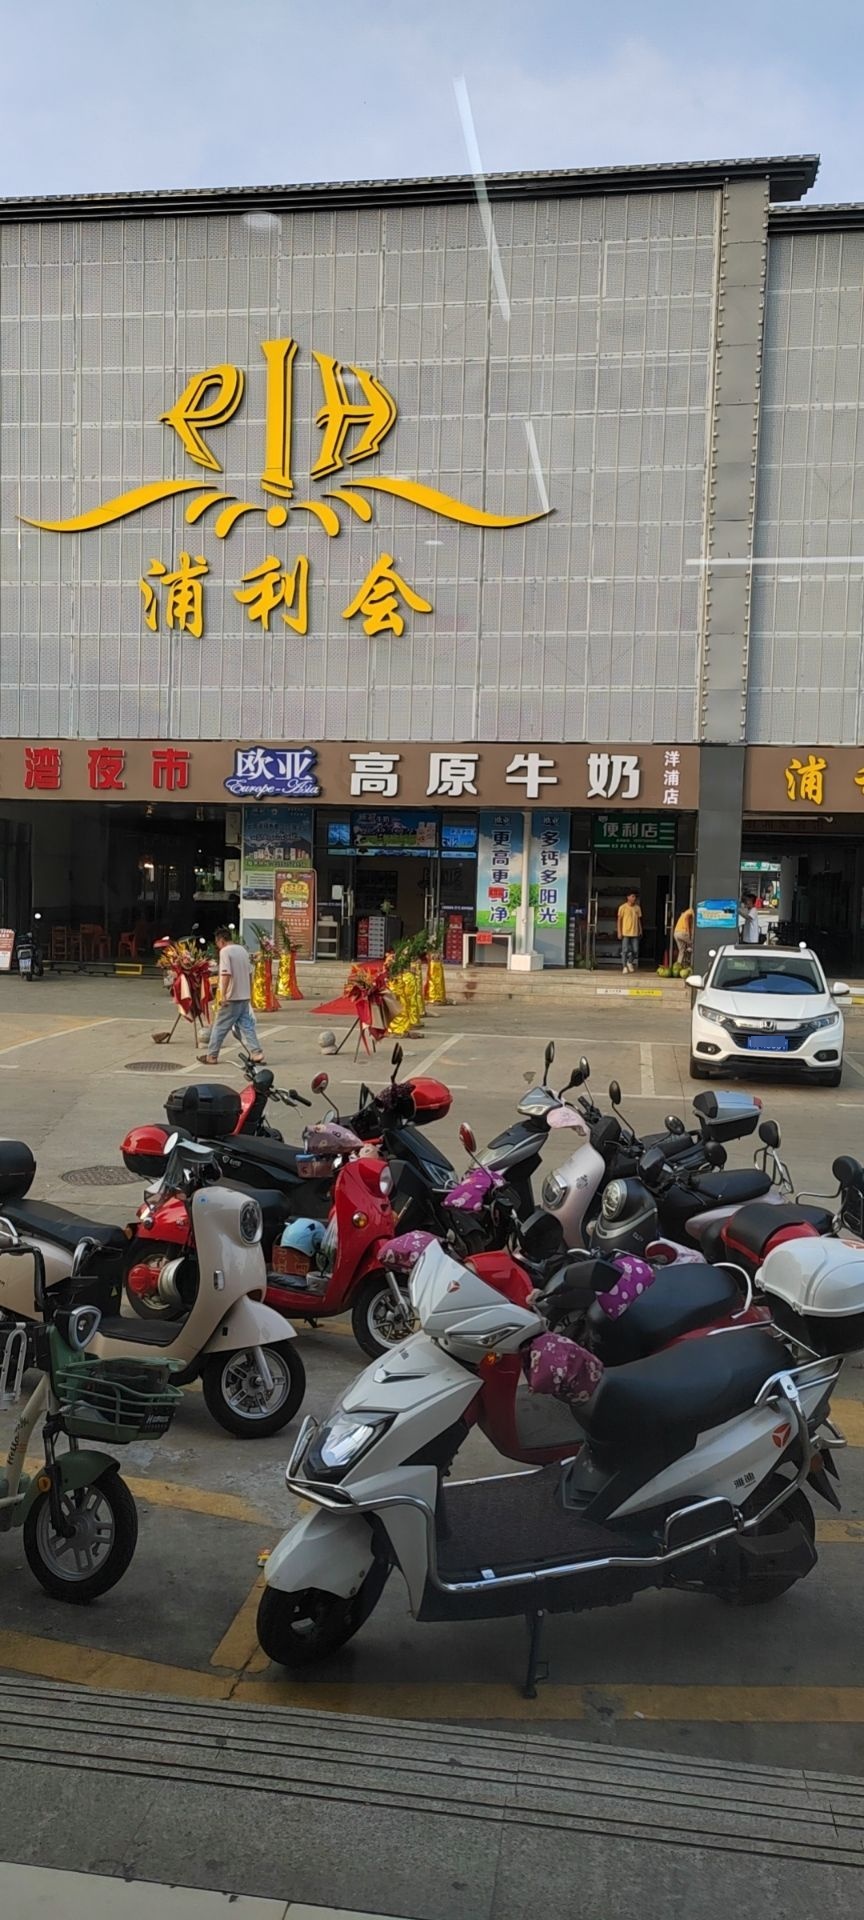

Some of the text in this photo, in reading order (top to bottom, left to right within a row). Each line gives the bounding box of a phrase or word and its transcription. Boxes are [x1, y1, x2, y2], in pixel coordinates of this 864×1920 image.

[139, 552, 433, 638] 浦利会
[24, 746, 192, 792] 湾夜市
[237, 747, 313, 780] 欧亚
[349, 751, 641, 799] 高原牛奶
[662, 750, 680, 805] 洋浦店
[784, 754, 864, 806] 浦
[225, 778, 319, 798] Europe-Asia
[603, 822, 658, 838] 便利店
[537, 830, 561, 924] 多钙多阳光
